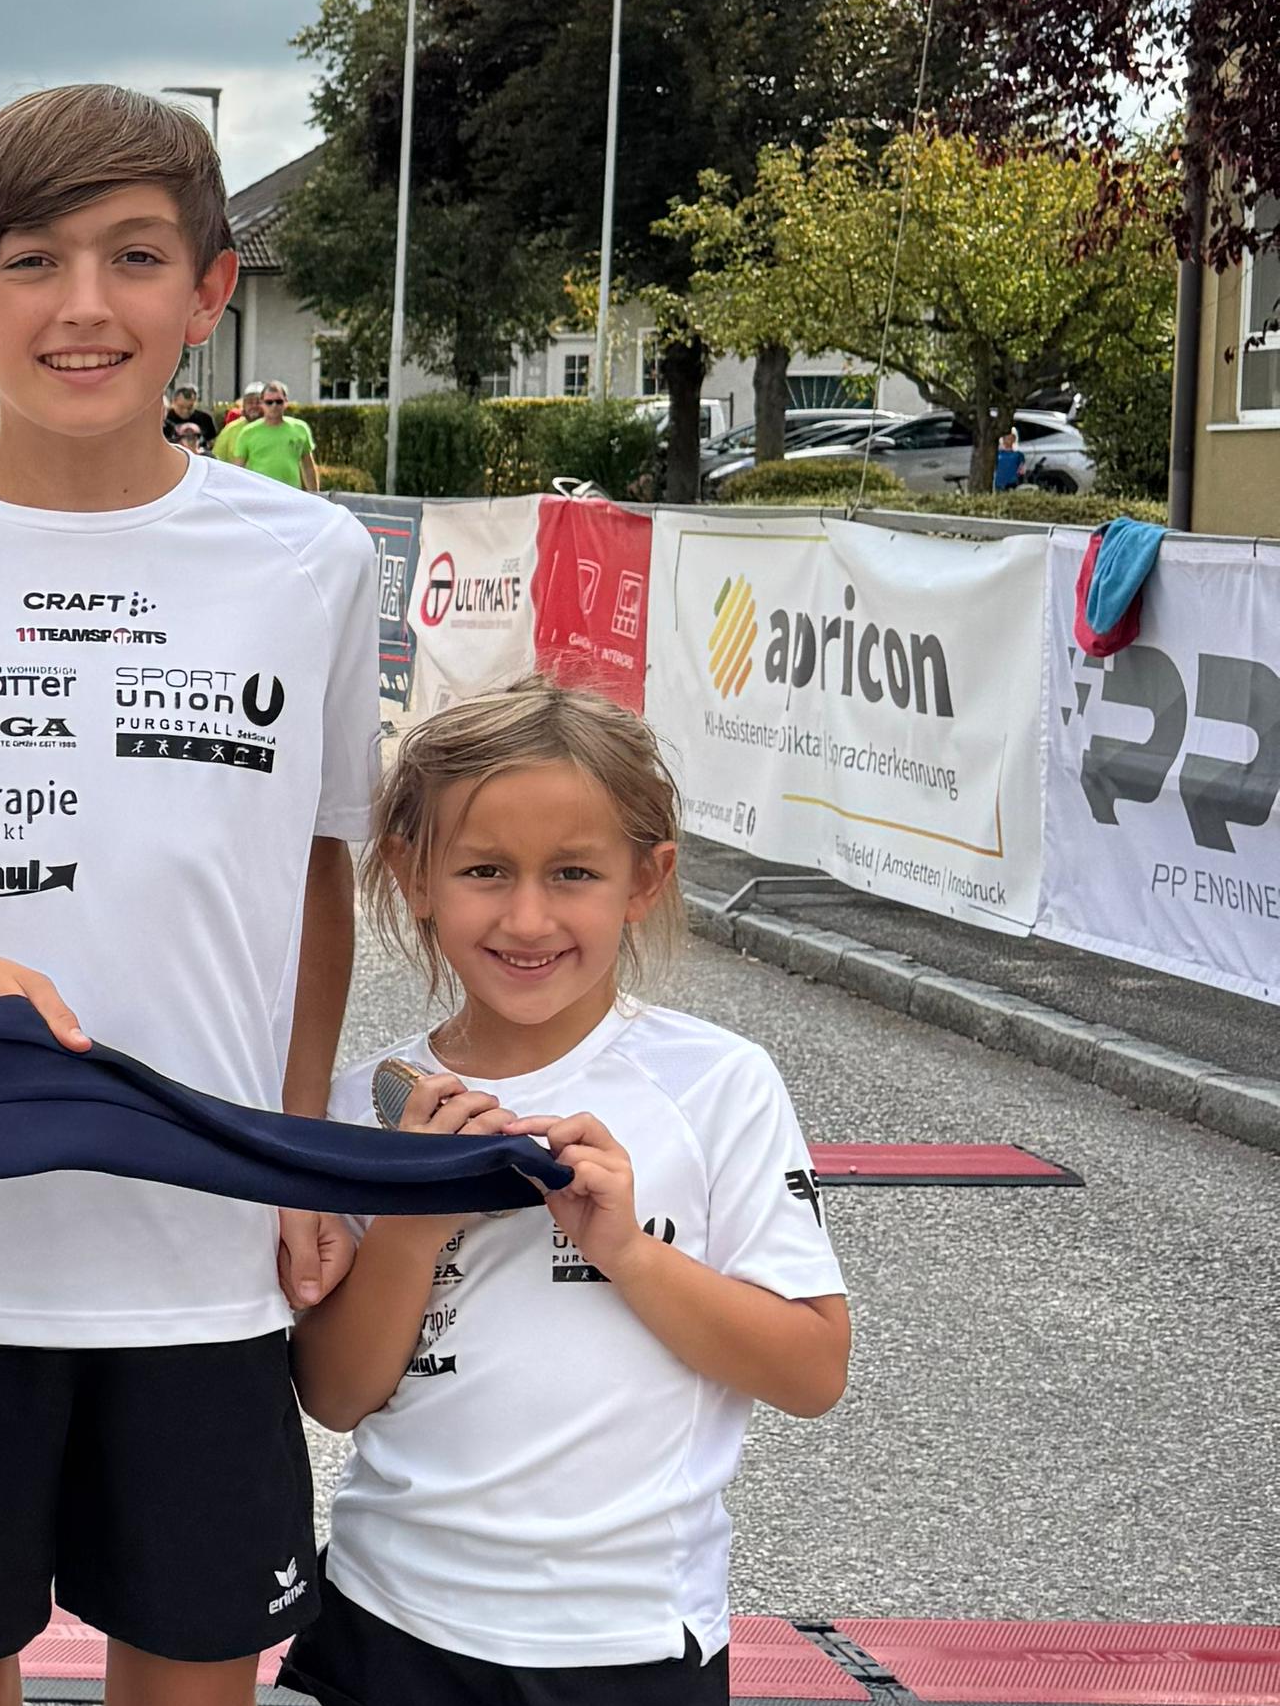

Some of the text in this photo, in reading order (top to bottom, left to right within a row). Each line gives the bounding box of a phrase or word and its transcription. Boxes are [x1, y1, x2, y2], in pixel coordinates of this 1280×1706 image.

[23, 592, 125, 614] CRAFT
[455, 577, 521, 612] ULTIMATE
[15, 626, 167, 645] 11TEAMSPORTS
[764, 583, 955, 718] apricon
[115, 666, 237, 692] SPORT
[115, 689, 234, 714] union
[115, 716, 233, 737] PURGSTALL
[882, 853, 940, 887] Amstetten
[1151, 863, 1280, 920] PP ENGINE
